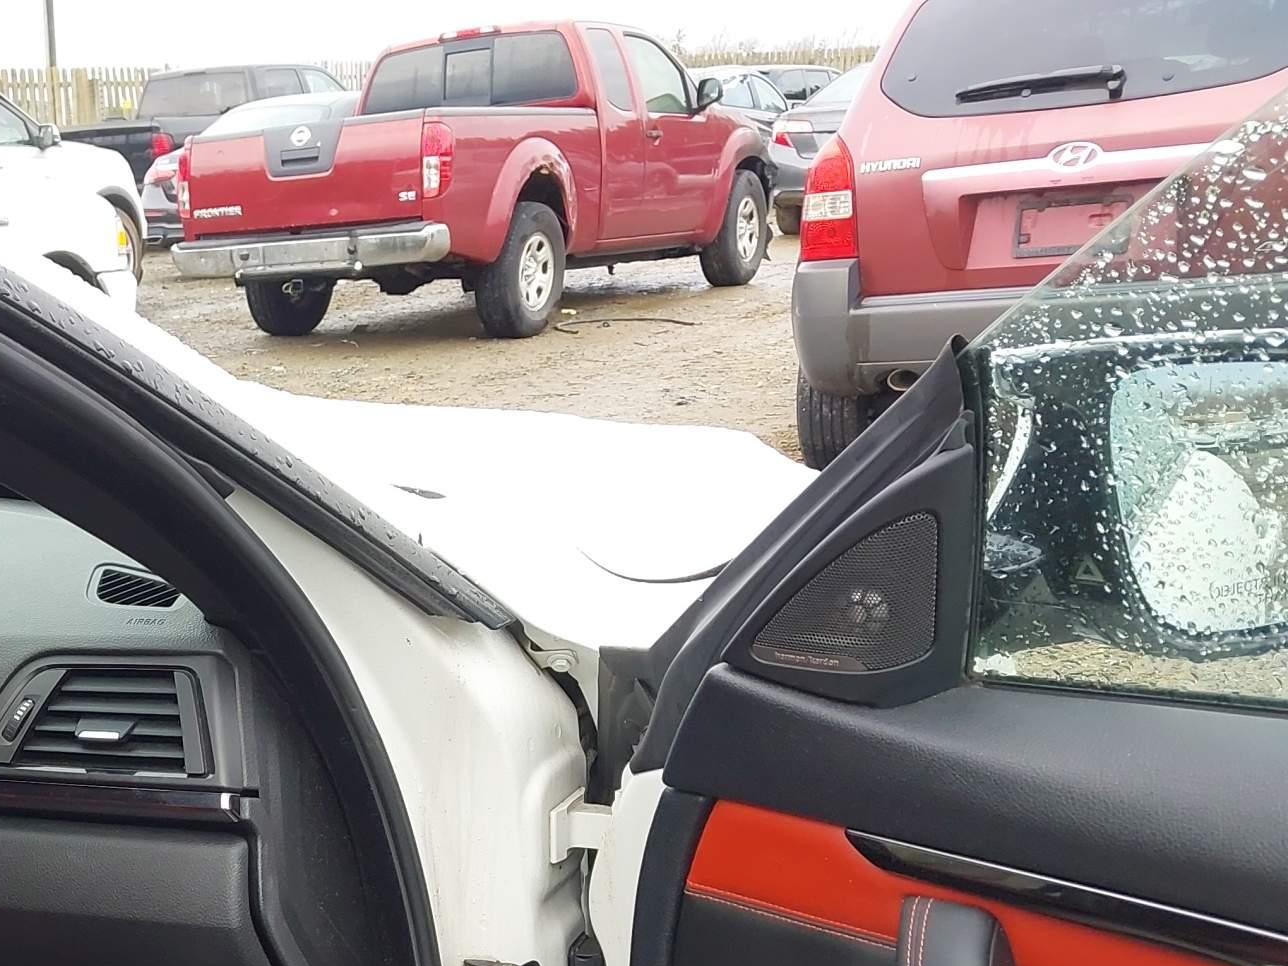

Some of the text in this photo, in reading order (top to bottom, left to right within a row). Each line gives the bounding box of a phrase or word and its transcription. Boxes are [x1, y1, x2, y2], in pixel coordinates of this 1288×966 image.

[859, 157, 920, 174] HYUNDAI
[398, 191, 416, 201] SE
[193, 205, 243, 219] FRONTIER
[126, 618, 167, 626] AIRBAG
